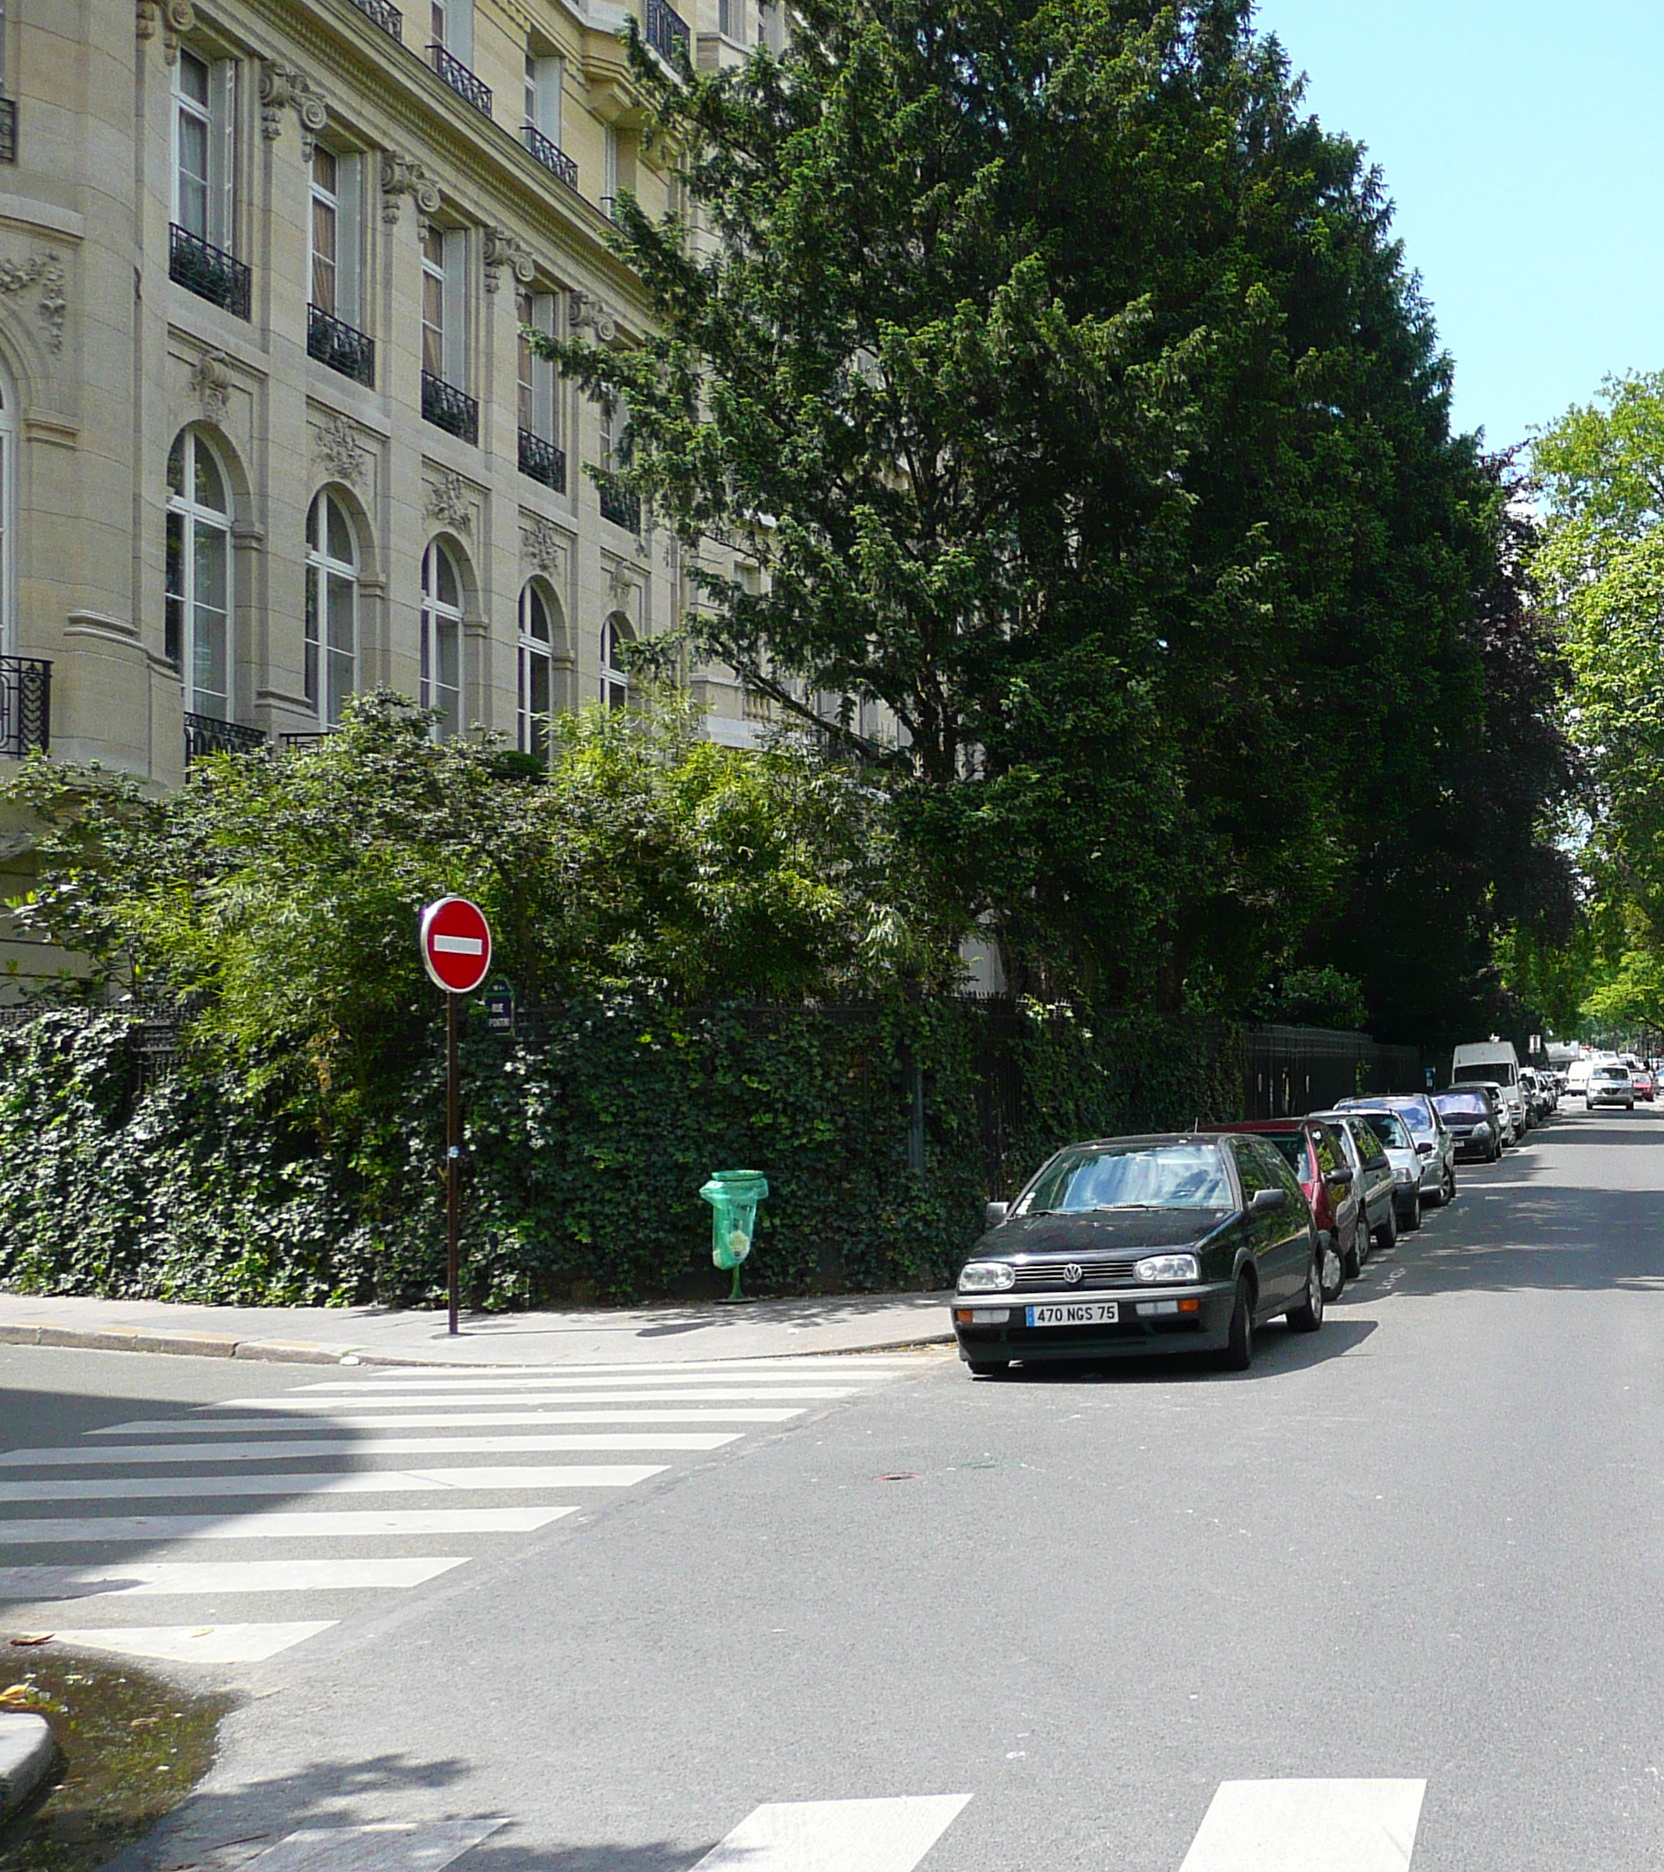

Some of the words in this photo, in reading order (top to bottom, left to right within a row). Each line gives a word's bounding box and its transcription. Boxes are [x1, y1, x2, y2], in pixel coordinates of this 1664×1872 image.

[1037, 1308, 1063, 1322] 470
[1067, 1307, 1093, 1321] NGS
[1097, 1305, 1115, 1319] 75
